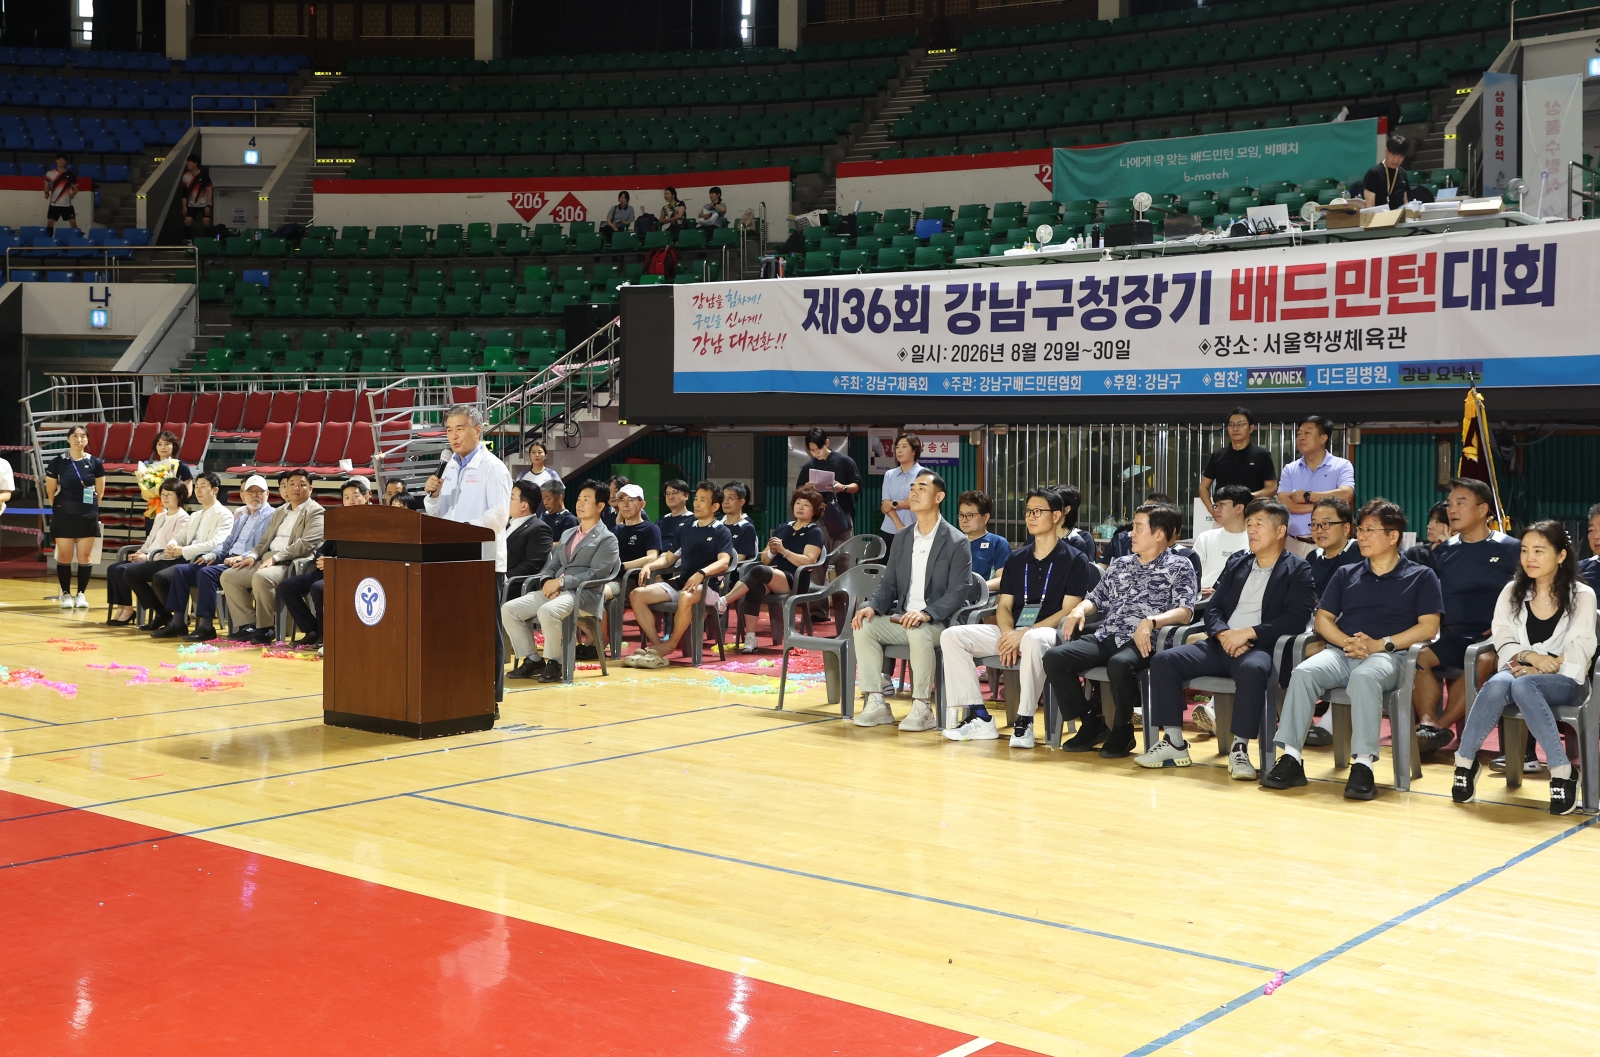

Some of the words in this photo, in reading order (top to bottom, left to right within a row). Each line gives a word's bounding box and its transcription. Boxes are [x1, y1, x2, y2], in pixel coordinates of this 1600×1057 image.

[248, 136, 257, 147] 4
[1119, 155, 1152, 169] 나에게
[1153, 154, 1165, 167] 딱
[1166, 153, 1189, 166] 맞는
[1190, 148, 1234, 163] 배드민턴
[1236, 145, 1262, 160] 모임,
[1264, 141, 1299, 157] 비매치
[1183, 168, 1229, 182] b-match
[514, 192, 542, 209] 206
[555, 205, 584, 222] 306
[89, 286, 112, 307] 나
[801, 283, 931, 335] 제36회
[944, 270, 1213, 335] 강남구청장기
[1229, 242, 1558, 324] 배드민턴대회
[692, 292, 723, 310] 강남을
[725, 288, 762, 309] 힘차게!
[692, 313, 722, 331] 구민을
[725, 311, 763, 329] 신나게!
[692, 331, 725, 355] 강남
[728, 330, 787, 353] 대전환!!
[911, 344, 948, 363] 일시:
[950, 343, 1005, 362] 2026년
[1011, 342, 1037, 362] 8월
[1043, 339, 1131, 361] 29일~30일
[1213, 335, 1258, 357] 장소:
[1263, 326, 1408, 355] 서울학생체육관
[840, 375, 863, 390] 주최:
[866, 375, 928, 392] 강남구체육회
[951, 376, 977, 391] 주관:
[979, 375, 1082, 392] 강남구배드민턴협회
[1113, 374, 1142, 390] 후원:
[1144, 373, 1181, 390] 강남구
[1213, 370, 1243, 388] 협찬:
[1269, 371, 1303, 385] YONEX
[1316, 365, 1392, 385] 더드림병원,
[1402, 367, 1431, 382] 강남
[1436, 365, 1480, 381] 요넥스
